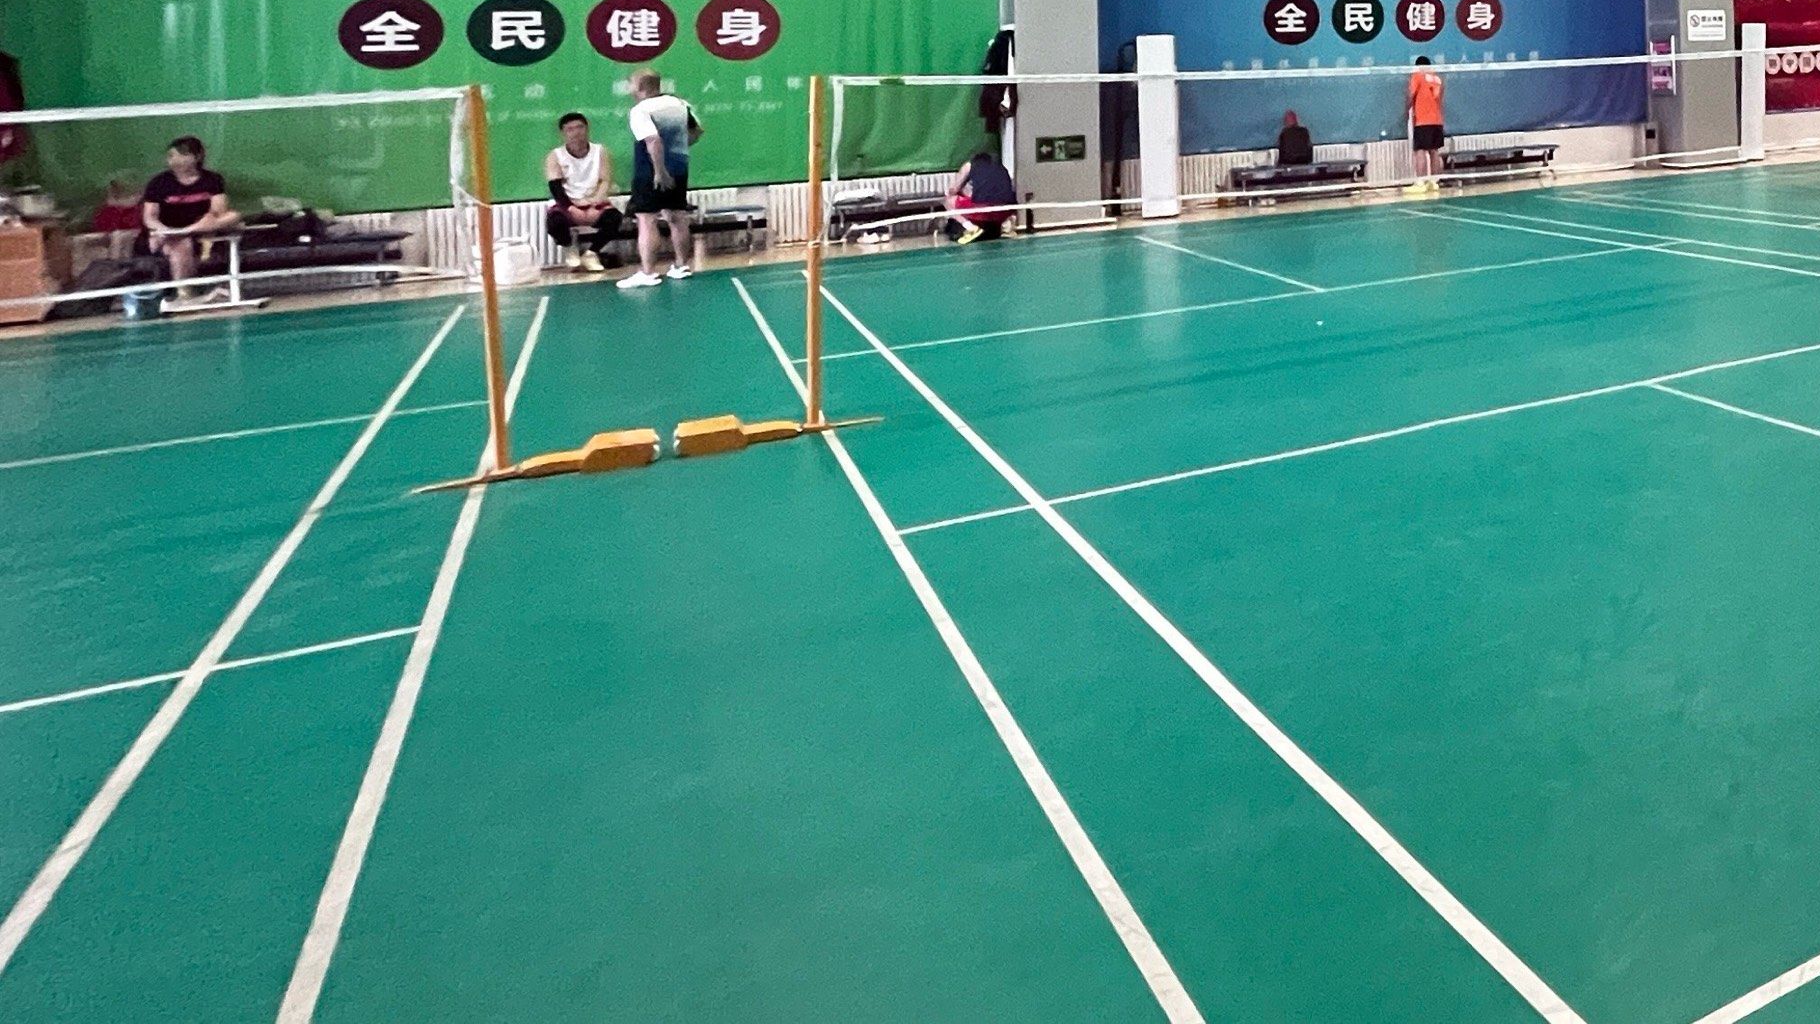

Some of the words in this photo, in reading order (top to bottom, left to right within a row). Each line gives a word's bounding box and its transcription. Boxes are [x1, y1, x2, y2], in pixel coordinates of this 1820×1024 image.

[359, 10, 768, 50] 全民健身
[1274, 1, 1496, 33] 全民健身
